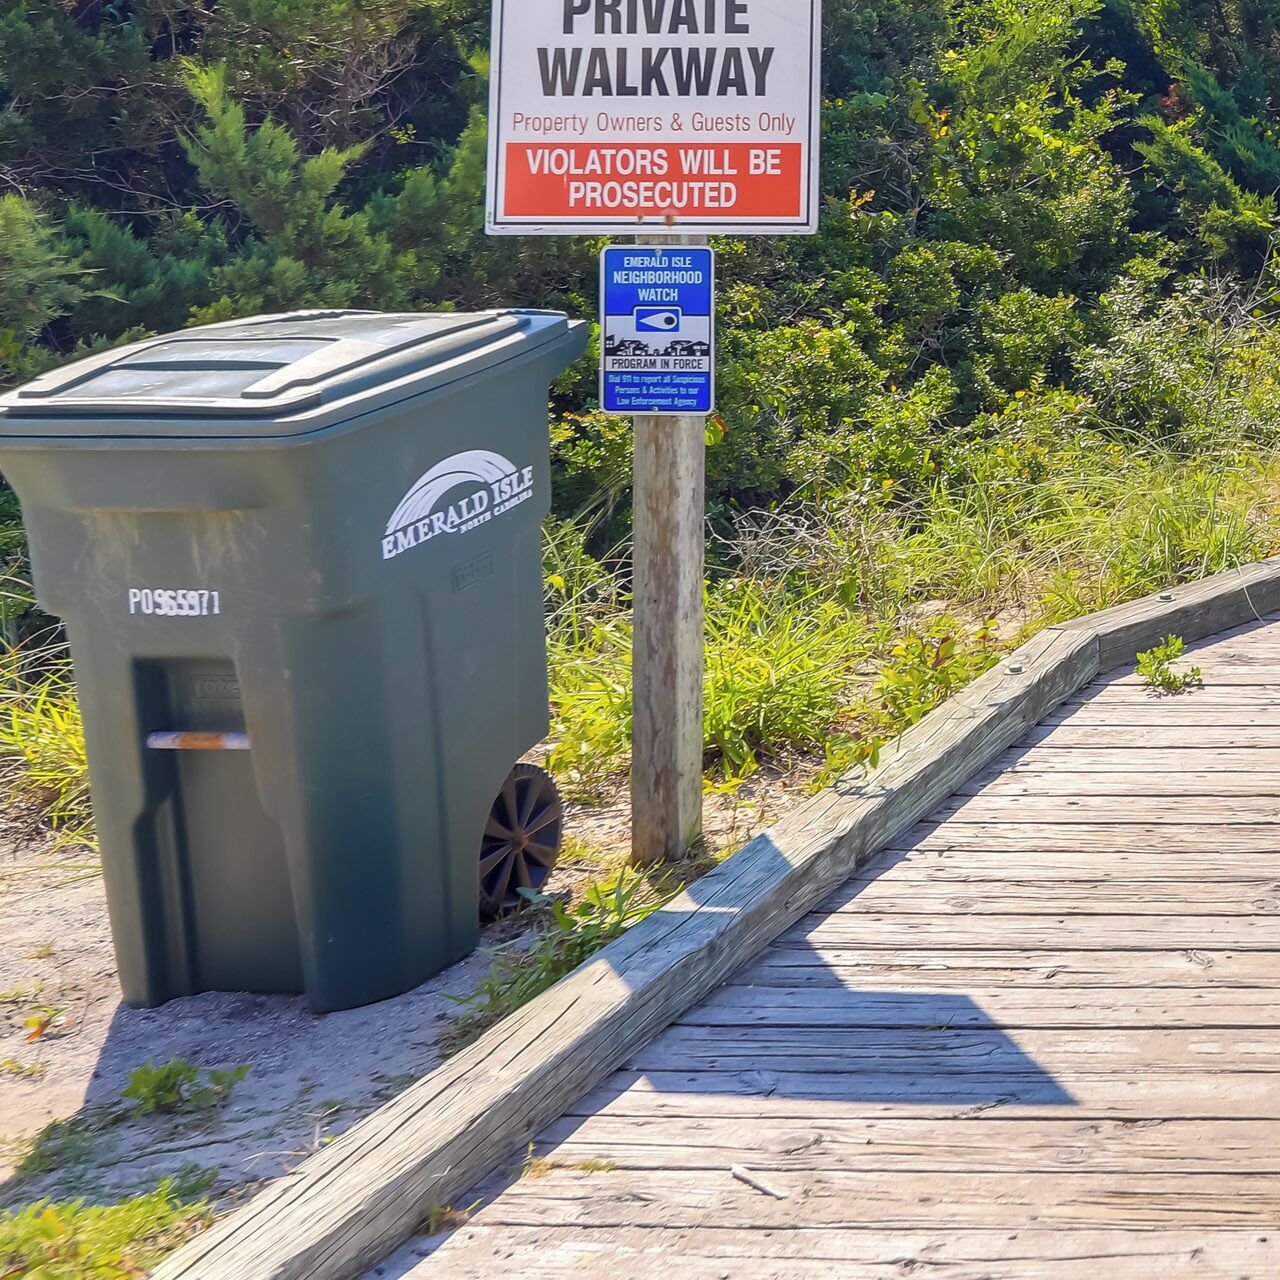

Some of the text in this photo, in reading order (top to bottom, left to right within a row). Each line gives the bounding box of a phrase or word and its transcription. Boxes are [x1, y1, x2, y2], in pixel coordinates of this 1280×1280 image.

[537, 47, 775, 96] WALKWAY
[512, 112, 795, 135] Property Owners & Guests Only
[526, 149, 781, 175] VIOLATORS WILL BE
[568, 182, 737, 208] PROSECUTED
[624, 257, 692, 268] EMERALD ISLE
[613, 271, 702, 284] NEIGHBORHOOD
[638, 288, 678, 301] WATCH
[612, 359, 703, 369] PROGRAM IN FORCE
[381, 465, 534, 560] EMERALD ISLE
